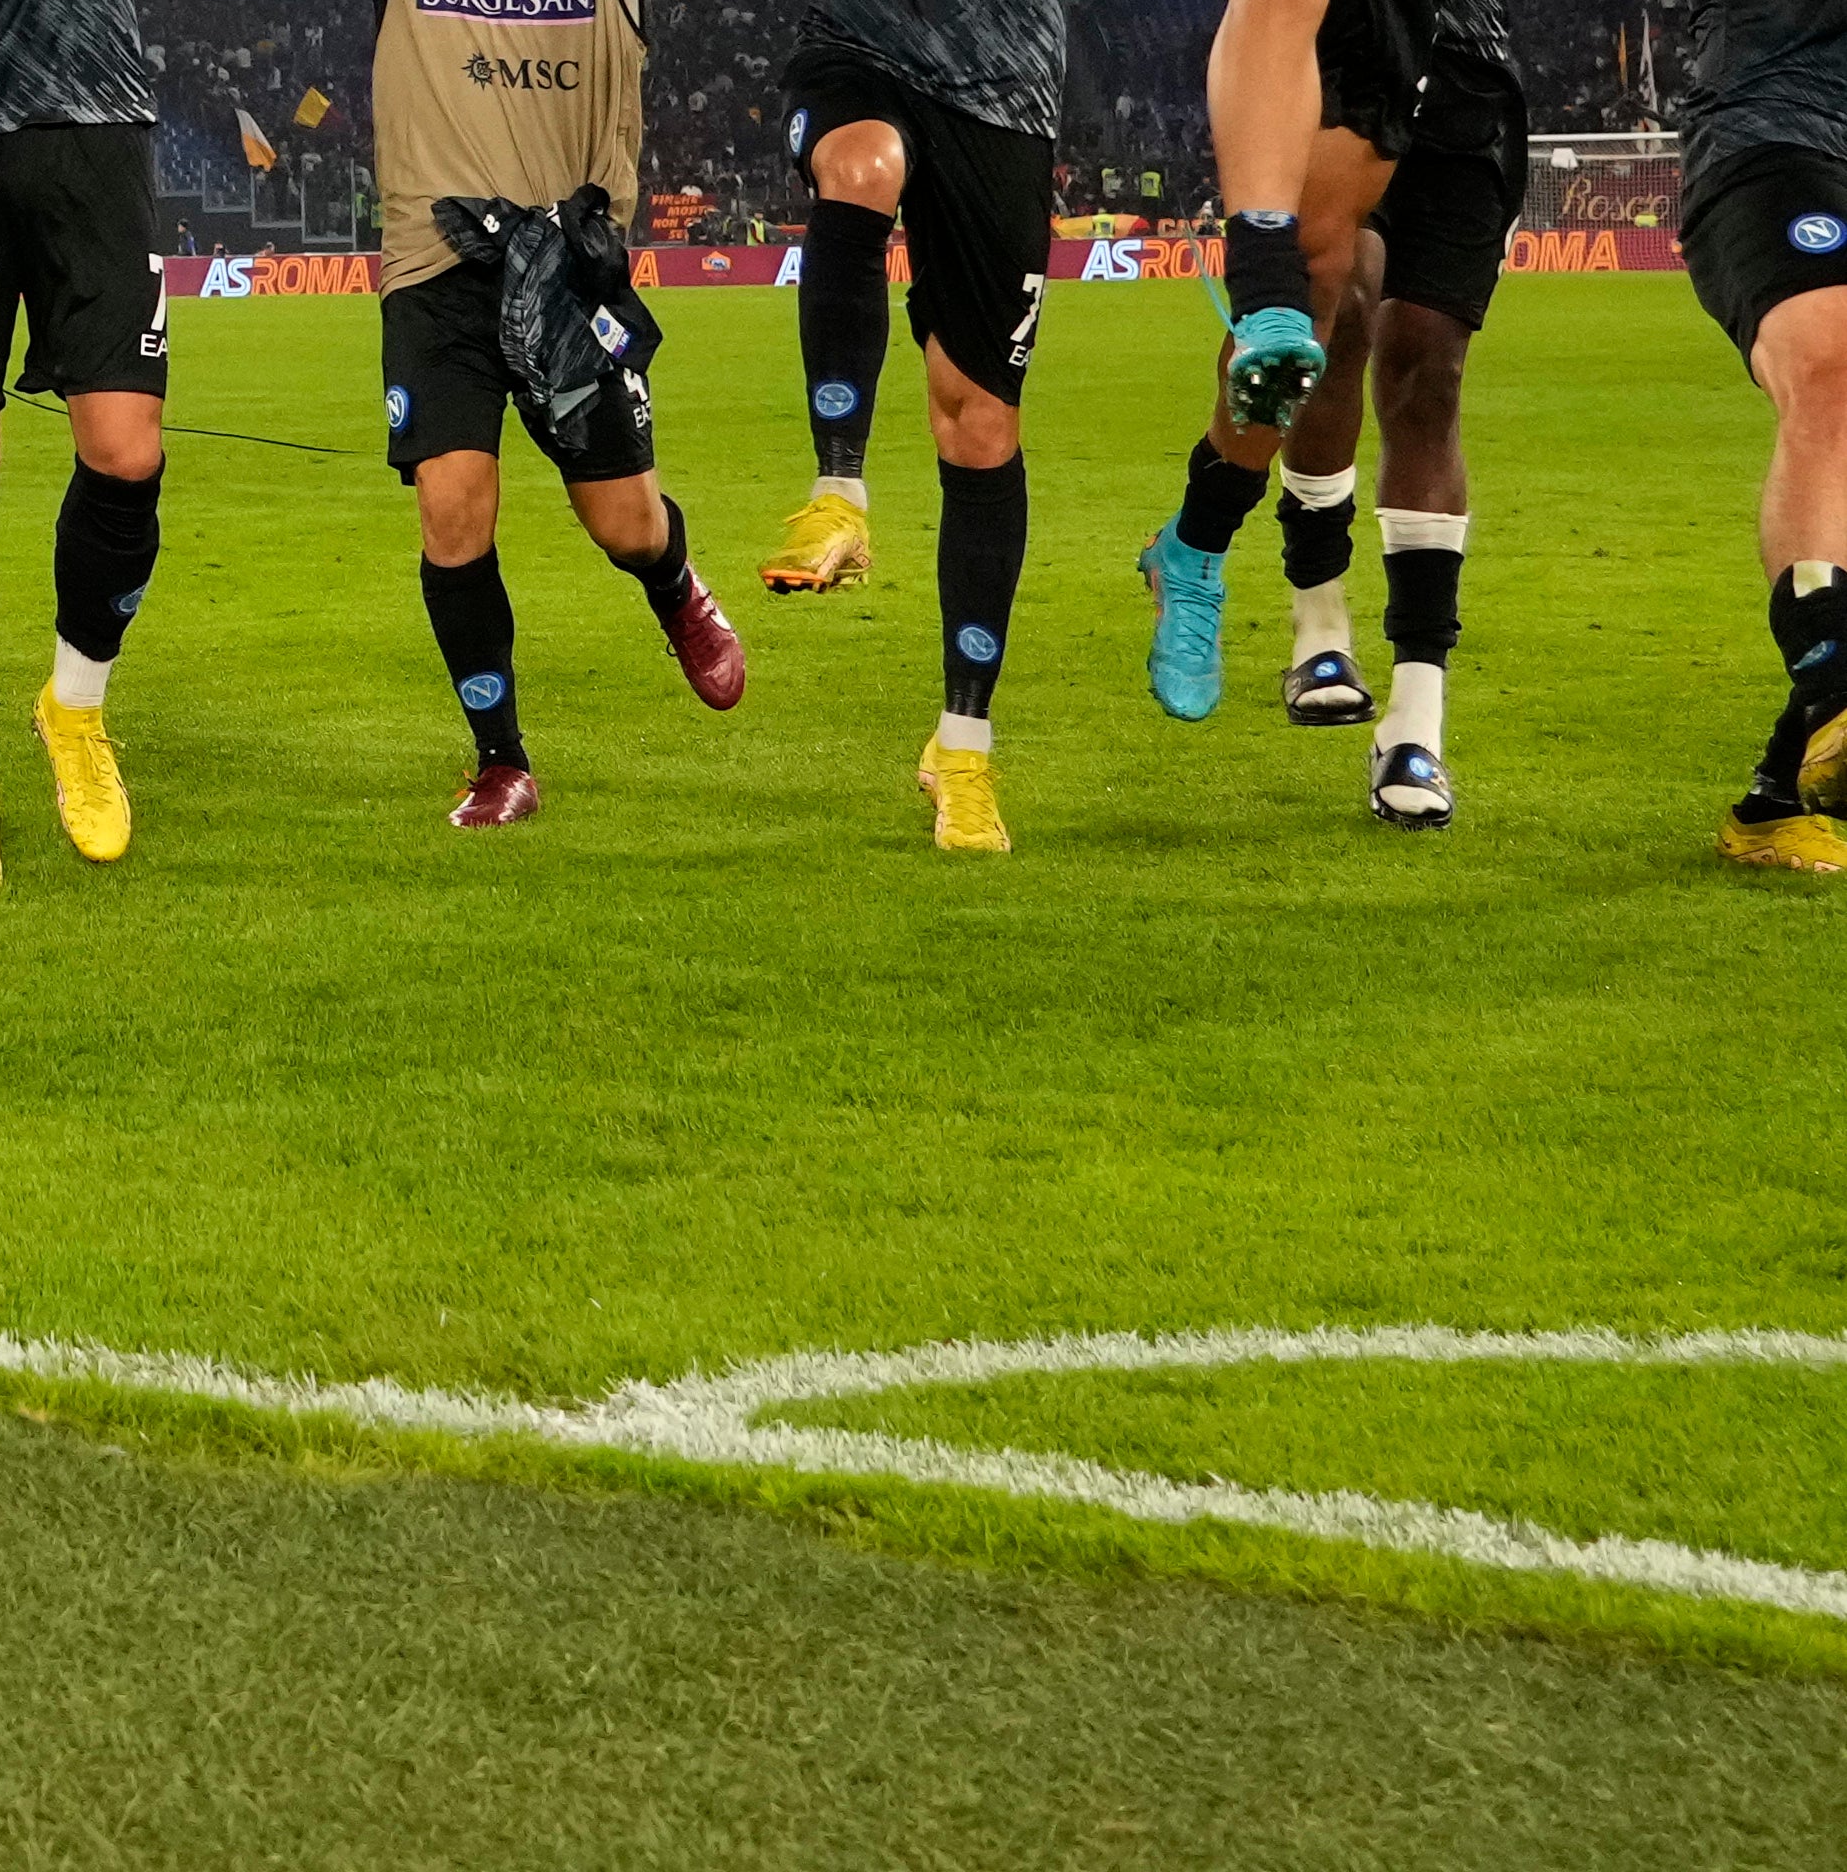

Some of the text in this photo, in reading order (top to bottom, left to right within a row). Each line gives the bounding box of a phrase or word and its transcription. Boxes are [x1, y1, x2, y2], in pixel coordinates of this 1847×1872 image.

[496, 58, 580, 91] MSC
[140, 334, 168, 358] EA
[1008, 344, 1031, 367] EA
